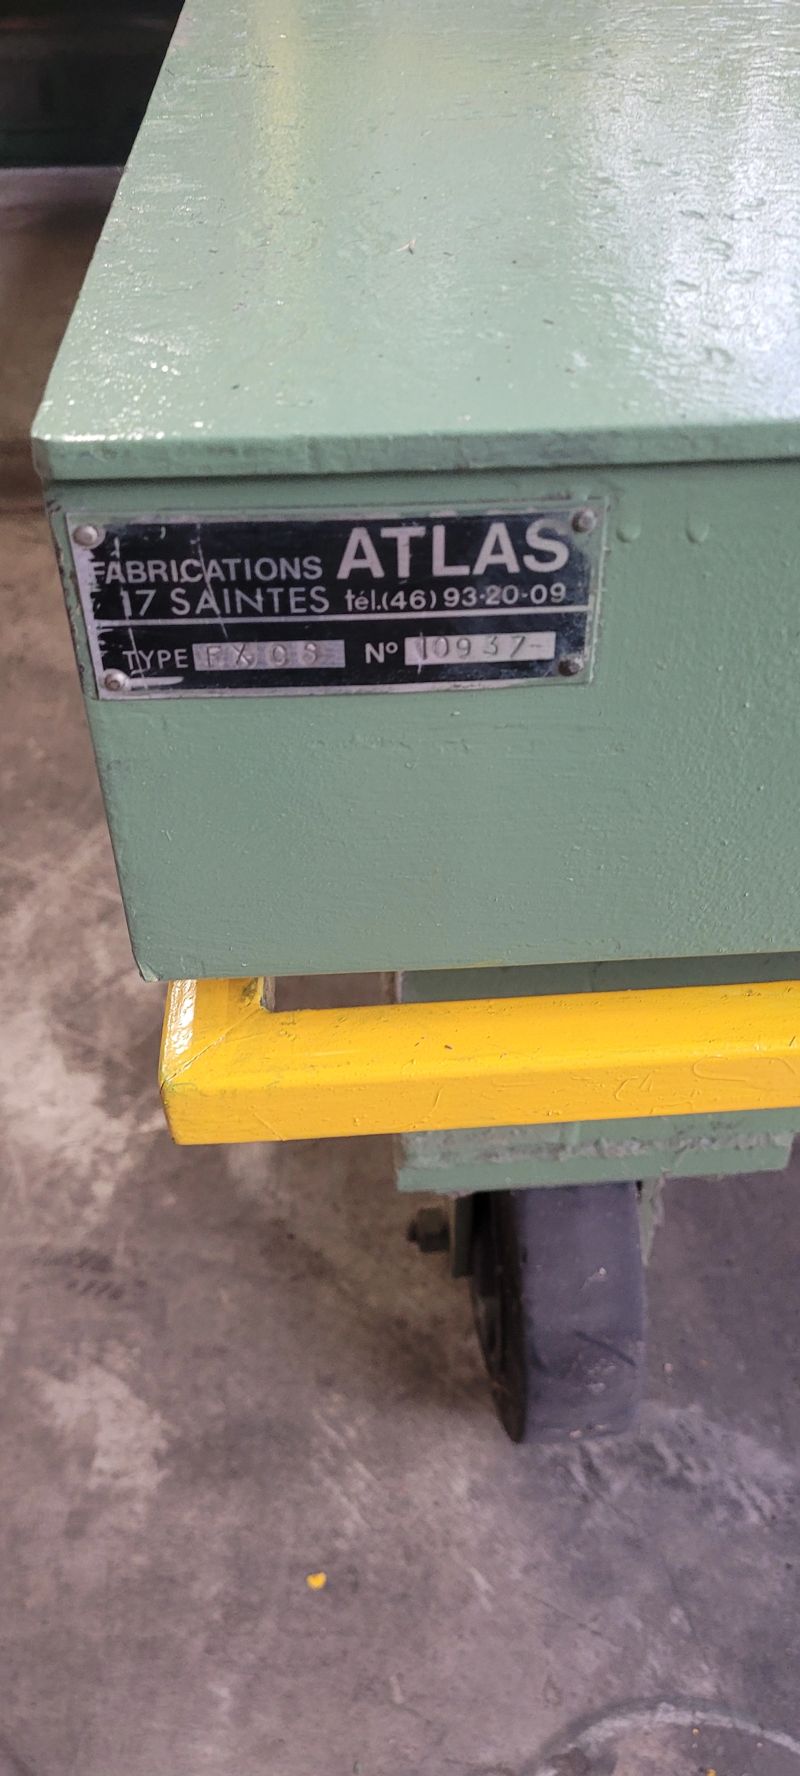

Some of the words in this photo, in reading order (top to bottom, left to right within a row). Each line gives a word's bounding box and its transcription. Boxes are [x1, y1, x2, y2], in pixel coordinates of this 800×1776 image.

[92, 556, 323, 584] FABRICATIONS
[336, 519, 570, 579] ATLAS
[122, 588, 156, 617] 17
[170, 586, 330, 616] SAINTES
[123, 649, 188, 670] TYPE
